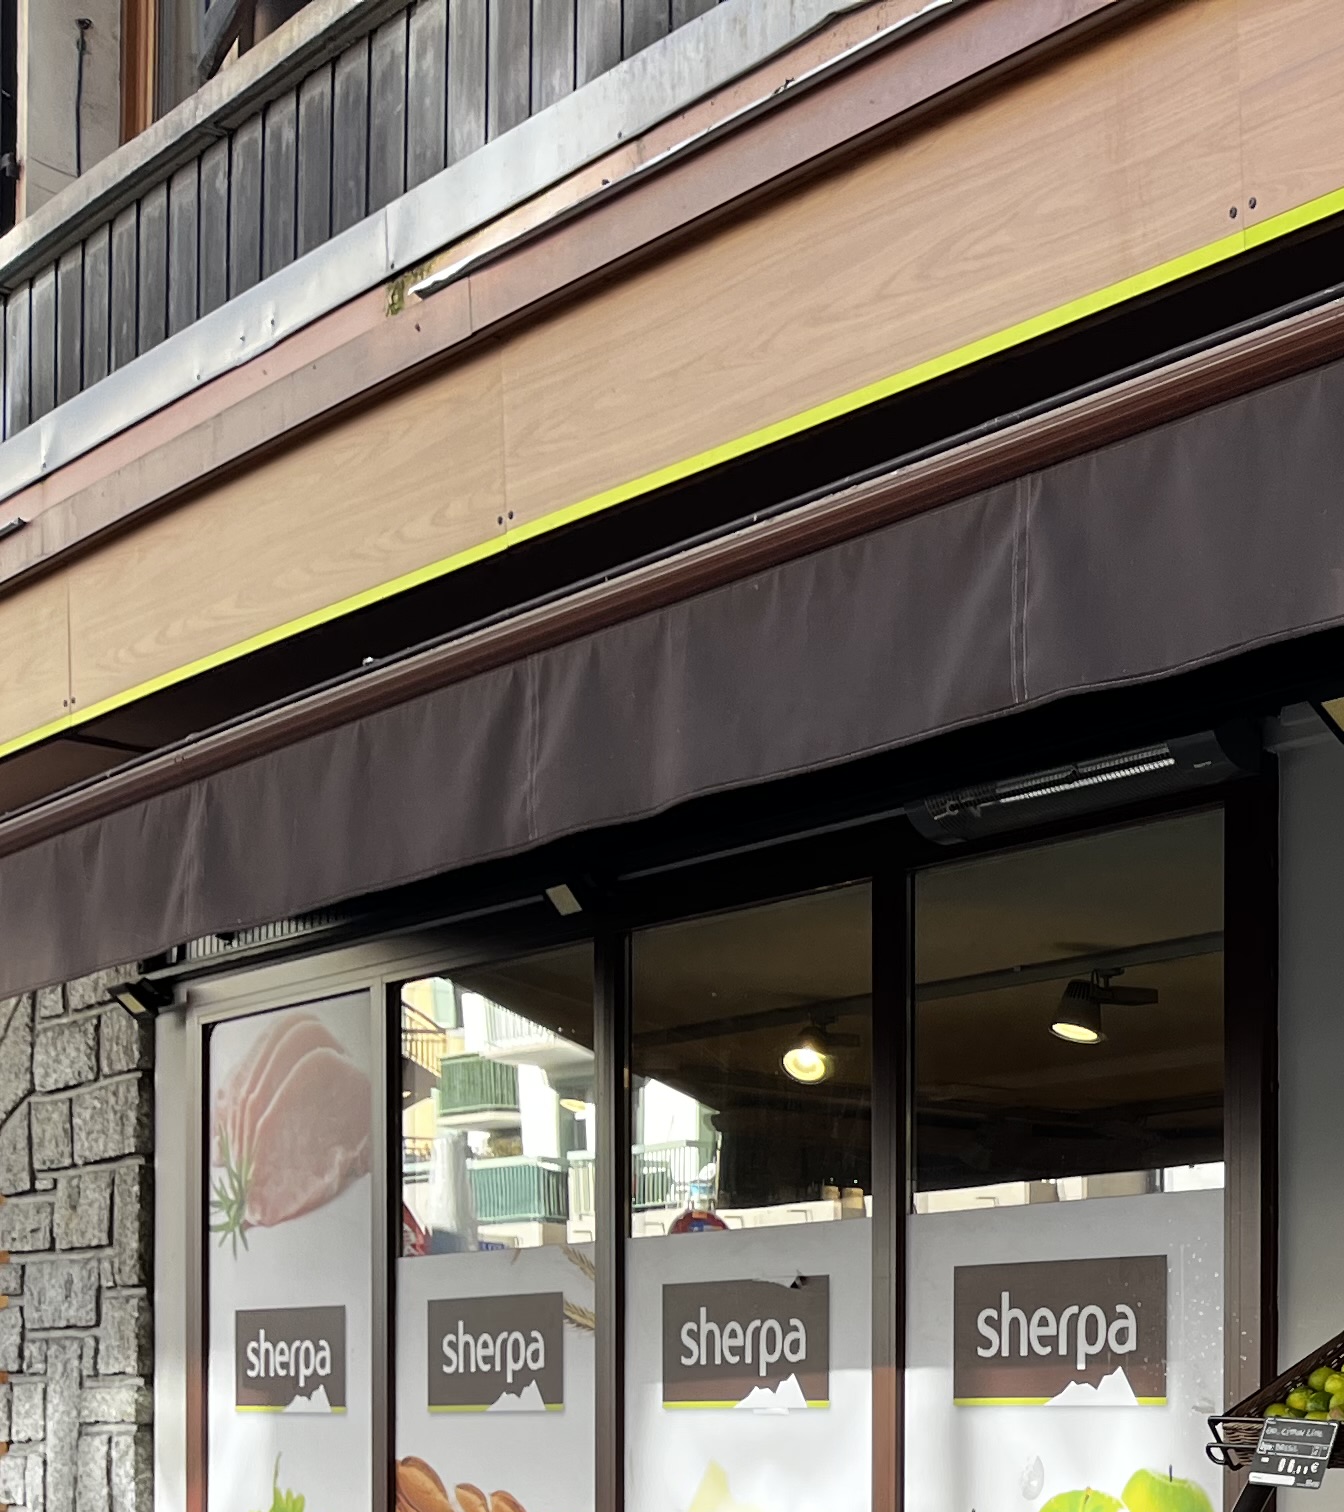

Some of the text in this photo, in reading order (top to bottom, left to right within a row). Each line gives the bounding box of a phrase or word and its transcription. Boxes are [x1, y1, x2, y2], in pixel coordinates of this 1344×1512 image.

[246, 1328, 331, 1388] sherpa
[442, 1320, 545, 1384] sherpa
[680, 1306, 807, 1377] sherpa
[976, 1291, 1137, 1371] sherpa
